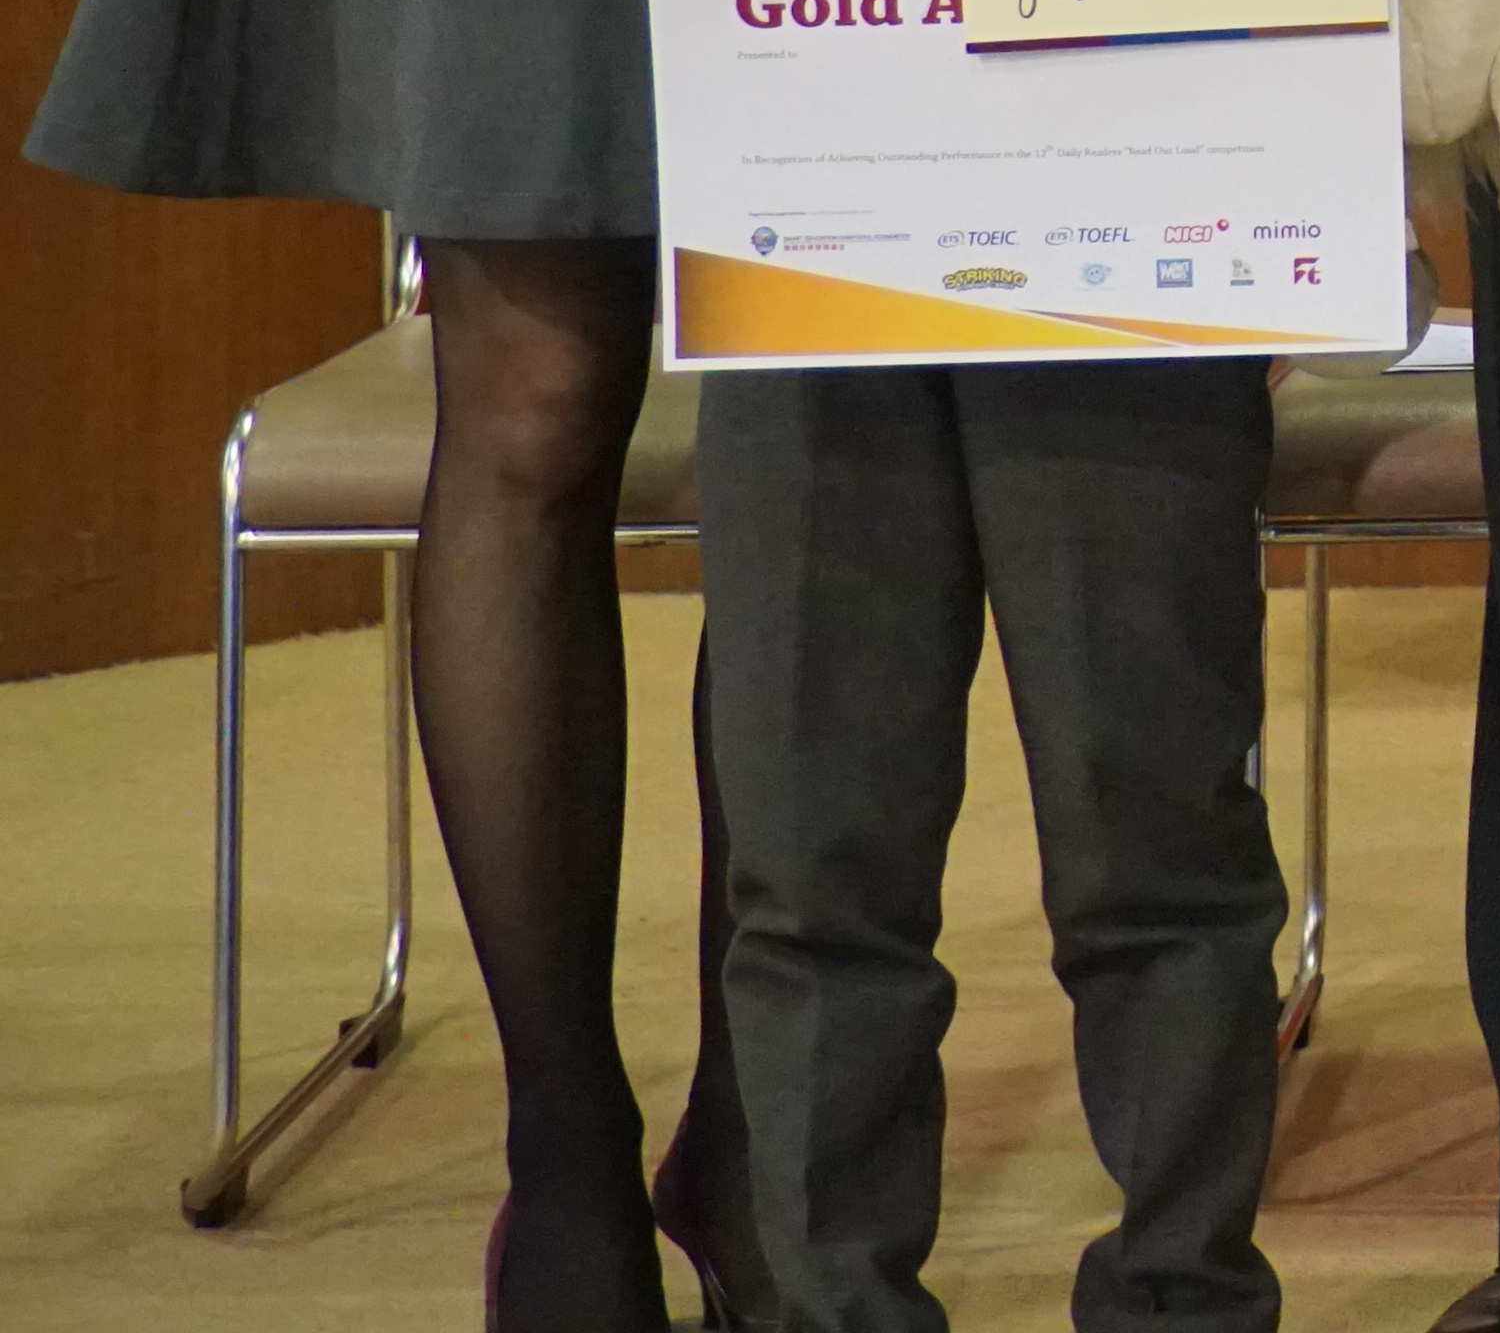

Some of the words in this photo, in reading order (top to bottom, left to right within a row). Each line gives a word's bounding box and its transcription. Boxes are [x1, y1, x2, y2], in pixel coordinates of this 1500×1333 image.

[967, 230, 1018, 246] TOEIC
[1078, 227, 1131, 243] TOEFL
[1164, 226, 1213, 244] NICI
[1253, 219, 1322, 240] mimio
[942, 267, 1029, 290] STRIKING
